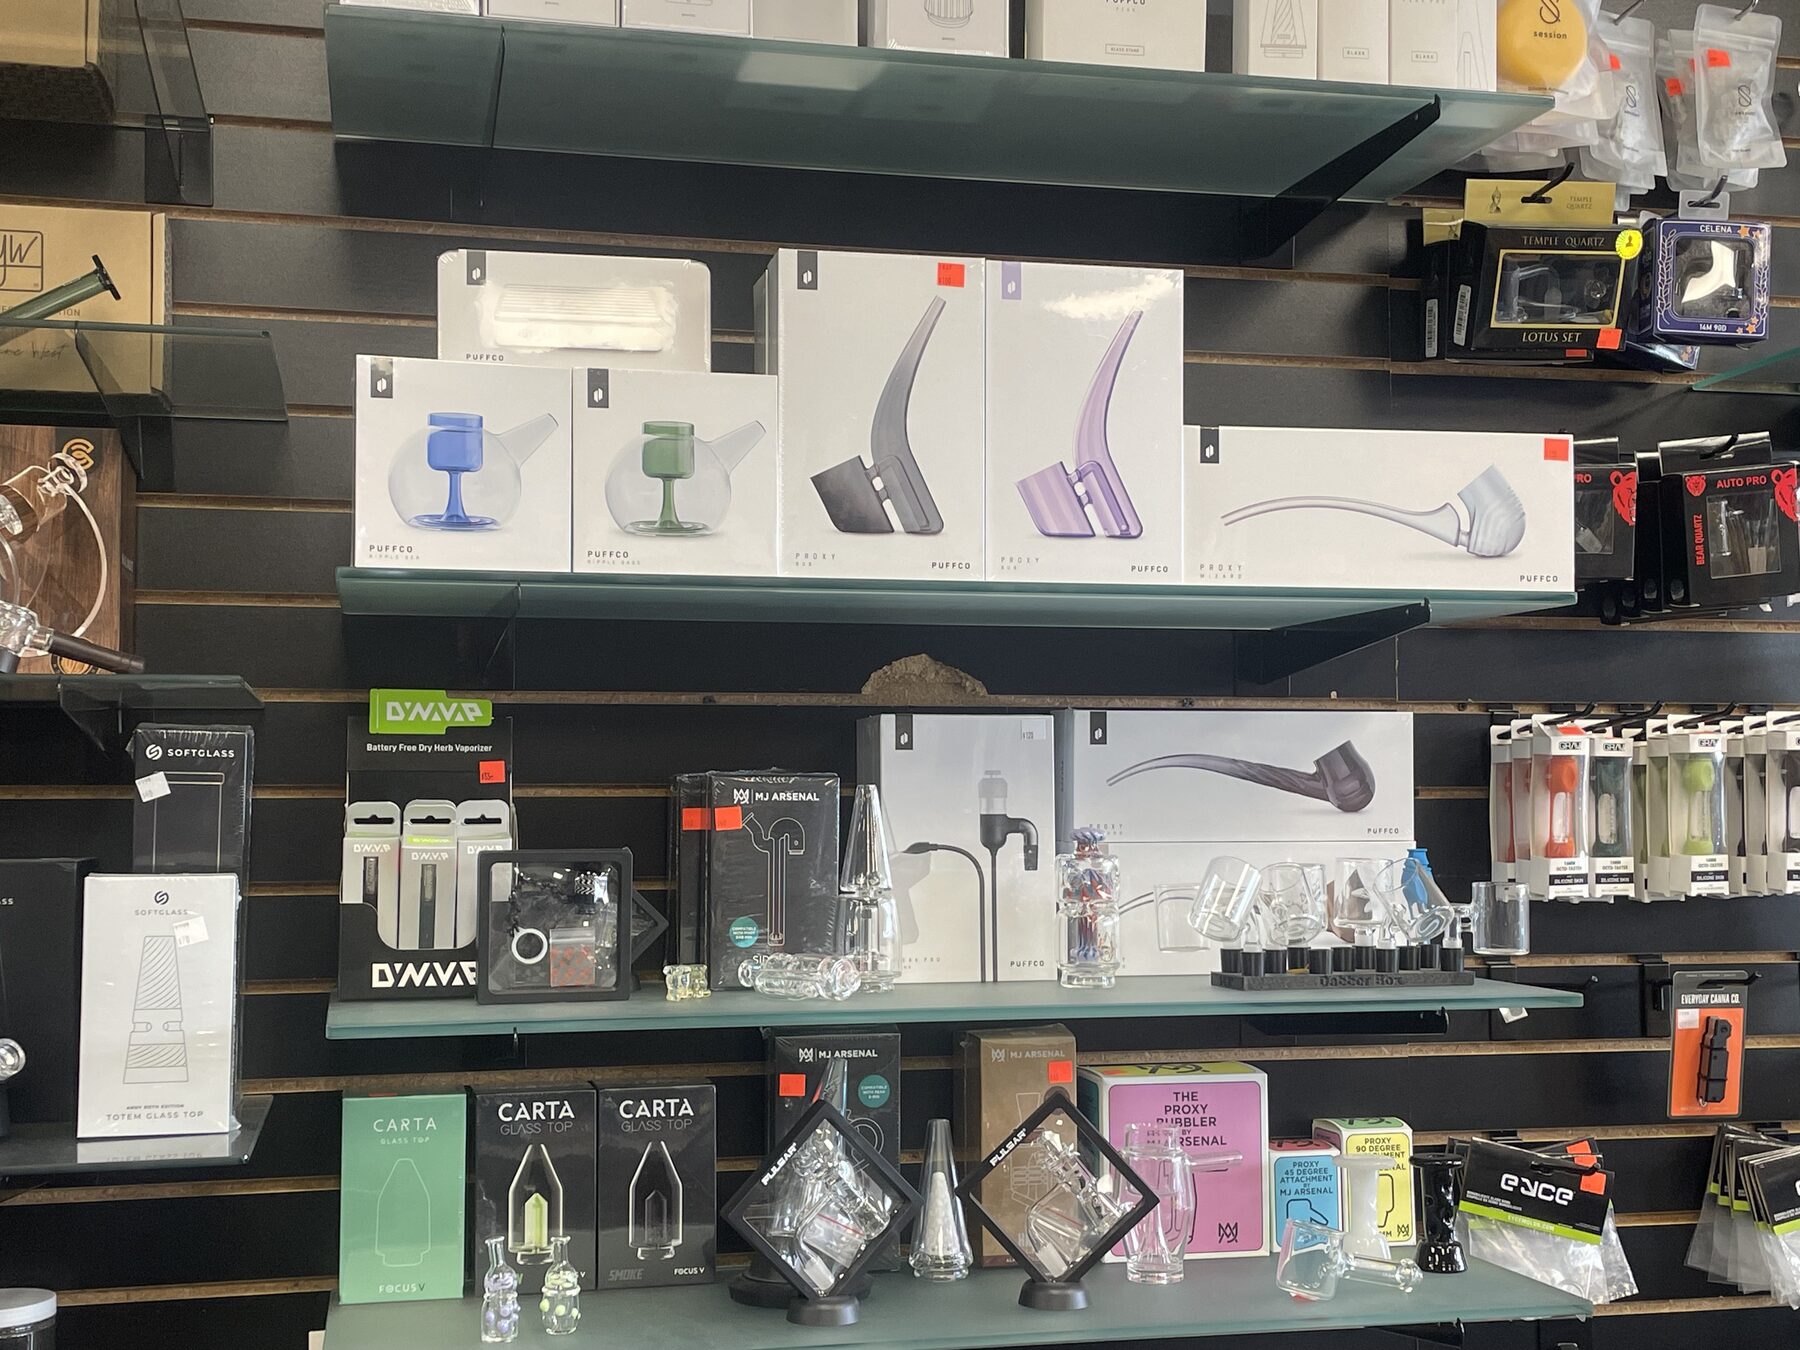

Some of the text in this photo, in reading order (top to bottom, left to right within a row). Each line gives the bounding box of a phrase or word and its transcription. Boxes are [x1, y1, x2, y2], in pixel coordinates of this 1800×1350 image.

[1533, 30, 1568, 39] session
[1700, 224, 1733, 234] CELENA
[1522, 236, 1605, 248] TEMPLE QUARTZ
[1522, 332, 1582, 343] LOTUS SET
[466, 353, 504, 362] PUFFCO
[1716, 475, 1767, 489] AUTO PRO
[1693, 514, 1705, 565] BEAR QUARTZ
[369, 545, 413, 553] PUFFCO
[587, 550, 629, 559] PUFFCO
[1131, 565, 1169, 573] PUFFCO
[1520, 575, 1558, 583] PUFFCO
[167, 748, 235, 758] SOFTGLASS
[366, 743, 493, 754] Battery Free Dry Herb Vaporizer
[755, 791, 820, 801] MJ ARSENAL
[1681, 993, 1741, 1004] EVERYDAY CANNA CO.
[818, 1049, 878, 1059] MJ ARSENAL
[1010, 1050, 1066, 1059] MJ ARSENAL
[1173, 1091, 1199, 1102] THE
[498, 1100, 575, 1122] CARTA
[619, 1098, 694, 1119] CARTA
[1164, 1103, 1209, 1115] PROXY
[106, 1110, 204, 1121] TOTEM GLASS TOP
[373, 1117, 437, 1133] CARTA
[500, 1121, 574, 1136] GLASS TOP
[621, 1118, 693, 1132] GLASS TOP
[380, 1136, 430, 1145] GLASS TOP
[1180, 1136, 1228, 1146] RSENAL
[1364, 1137, 1392, 1145] PROXY
[1355, 1144, 1401, 1153] 90 DEGREE
[1292, 1160, 1320, 1168] PROXY
[1296, 1168, 1329, 1176] DEGREE
[1280, 1174, 1333, 1184] ATTACHMENT
[1280, 1187, 1334, 1196] MJ ARSENAL
[608, 1268, 644, 1281] SMOKE
[674, 1266, 705, 1275] FOCUS V
[378, 1283, 425, 1294] FOCUS V
